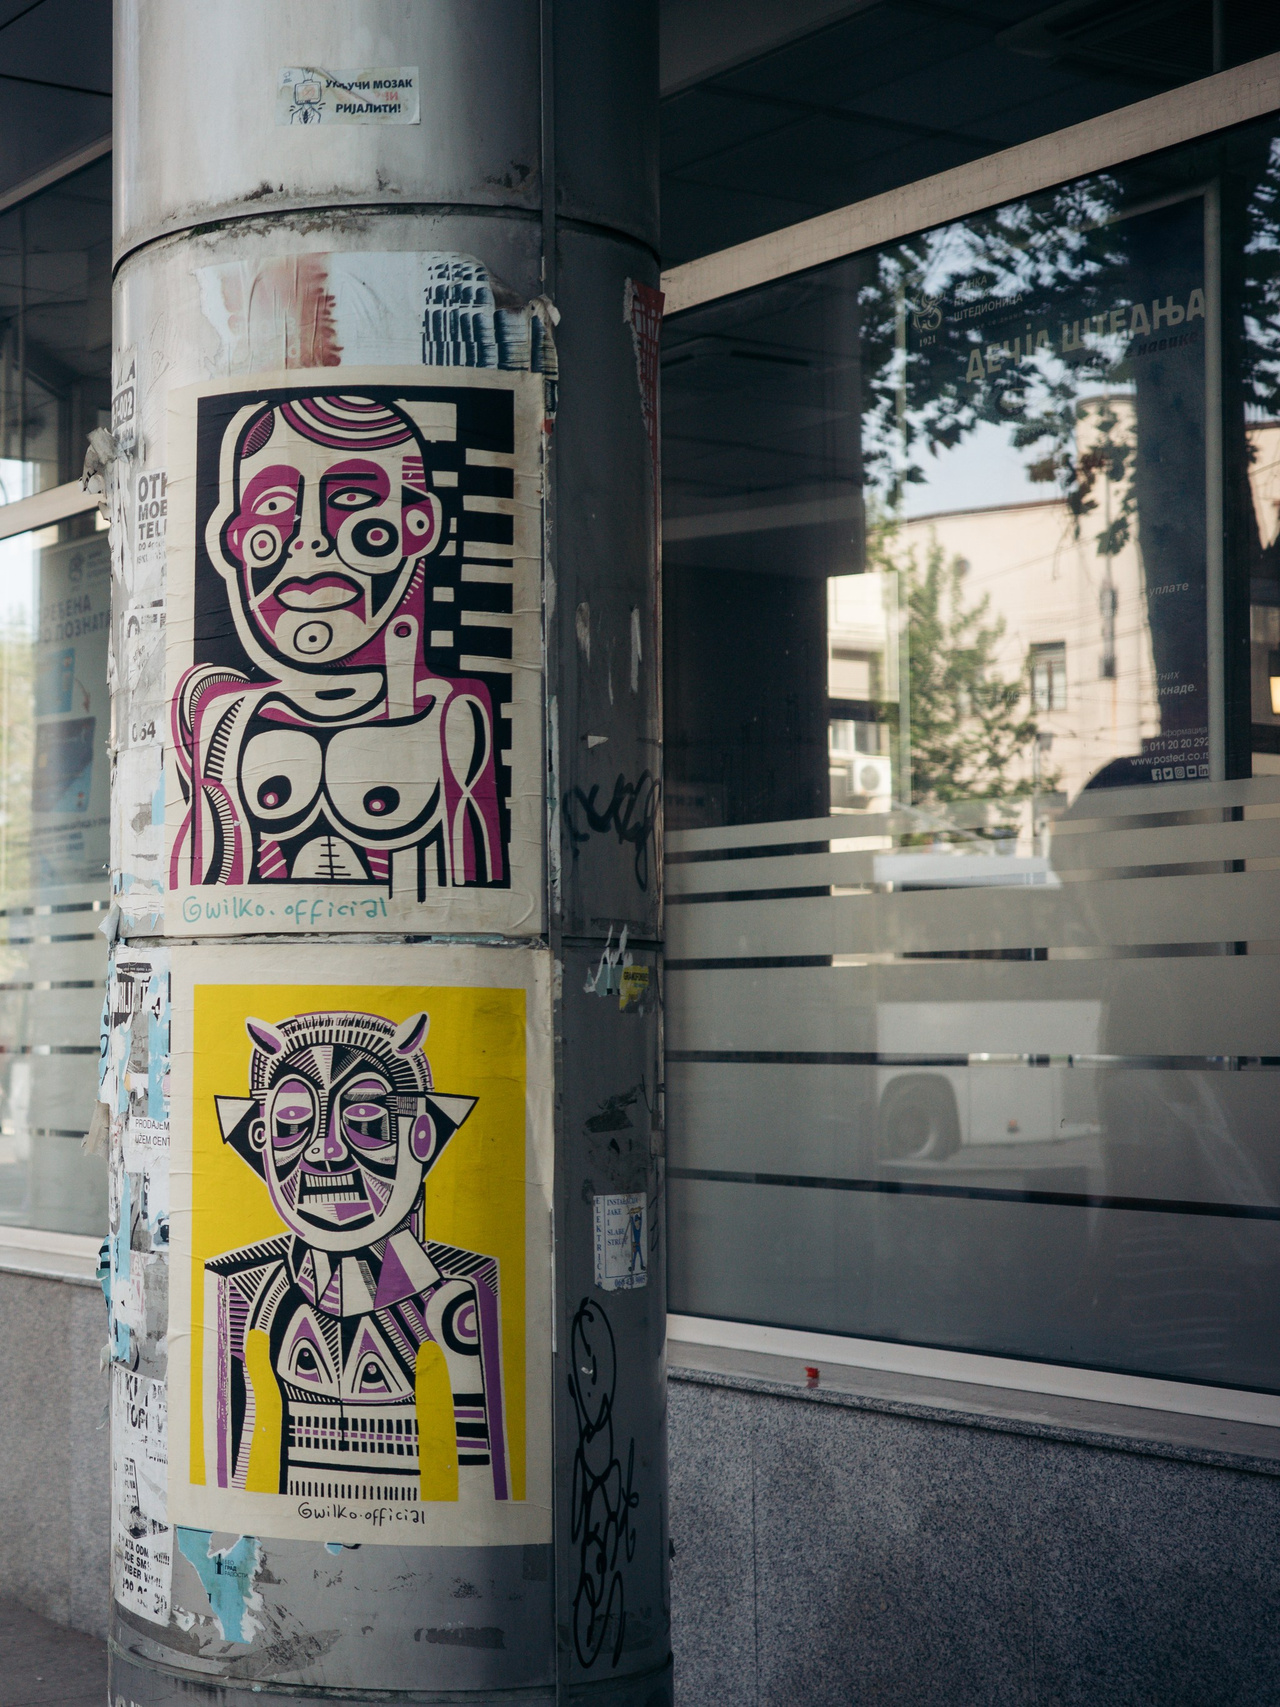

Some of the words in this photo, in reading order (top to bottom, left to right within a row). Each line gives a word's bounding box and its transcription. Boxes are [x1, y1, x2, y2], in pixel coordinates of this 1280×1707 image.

[373, 79, 413, 89] МОЗАК
[336, 103, 401, 114] РИЈАЛИТИ!
[1149, 582, 1189, 599] уплате
[1149, 741, 1166, 752] 011
[1168, 740, 1179, 750] 20
[1181, 738, 1192, 749] 20
